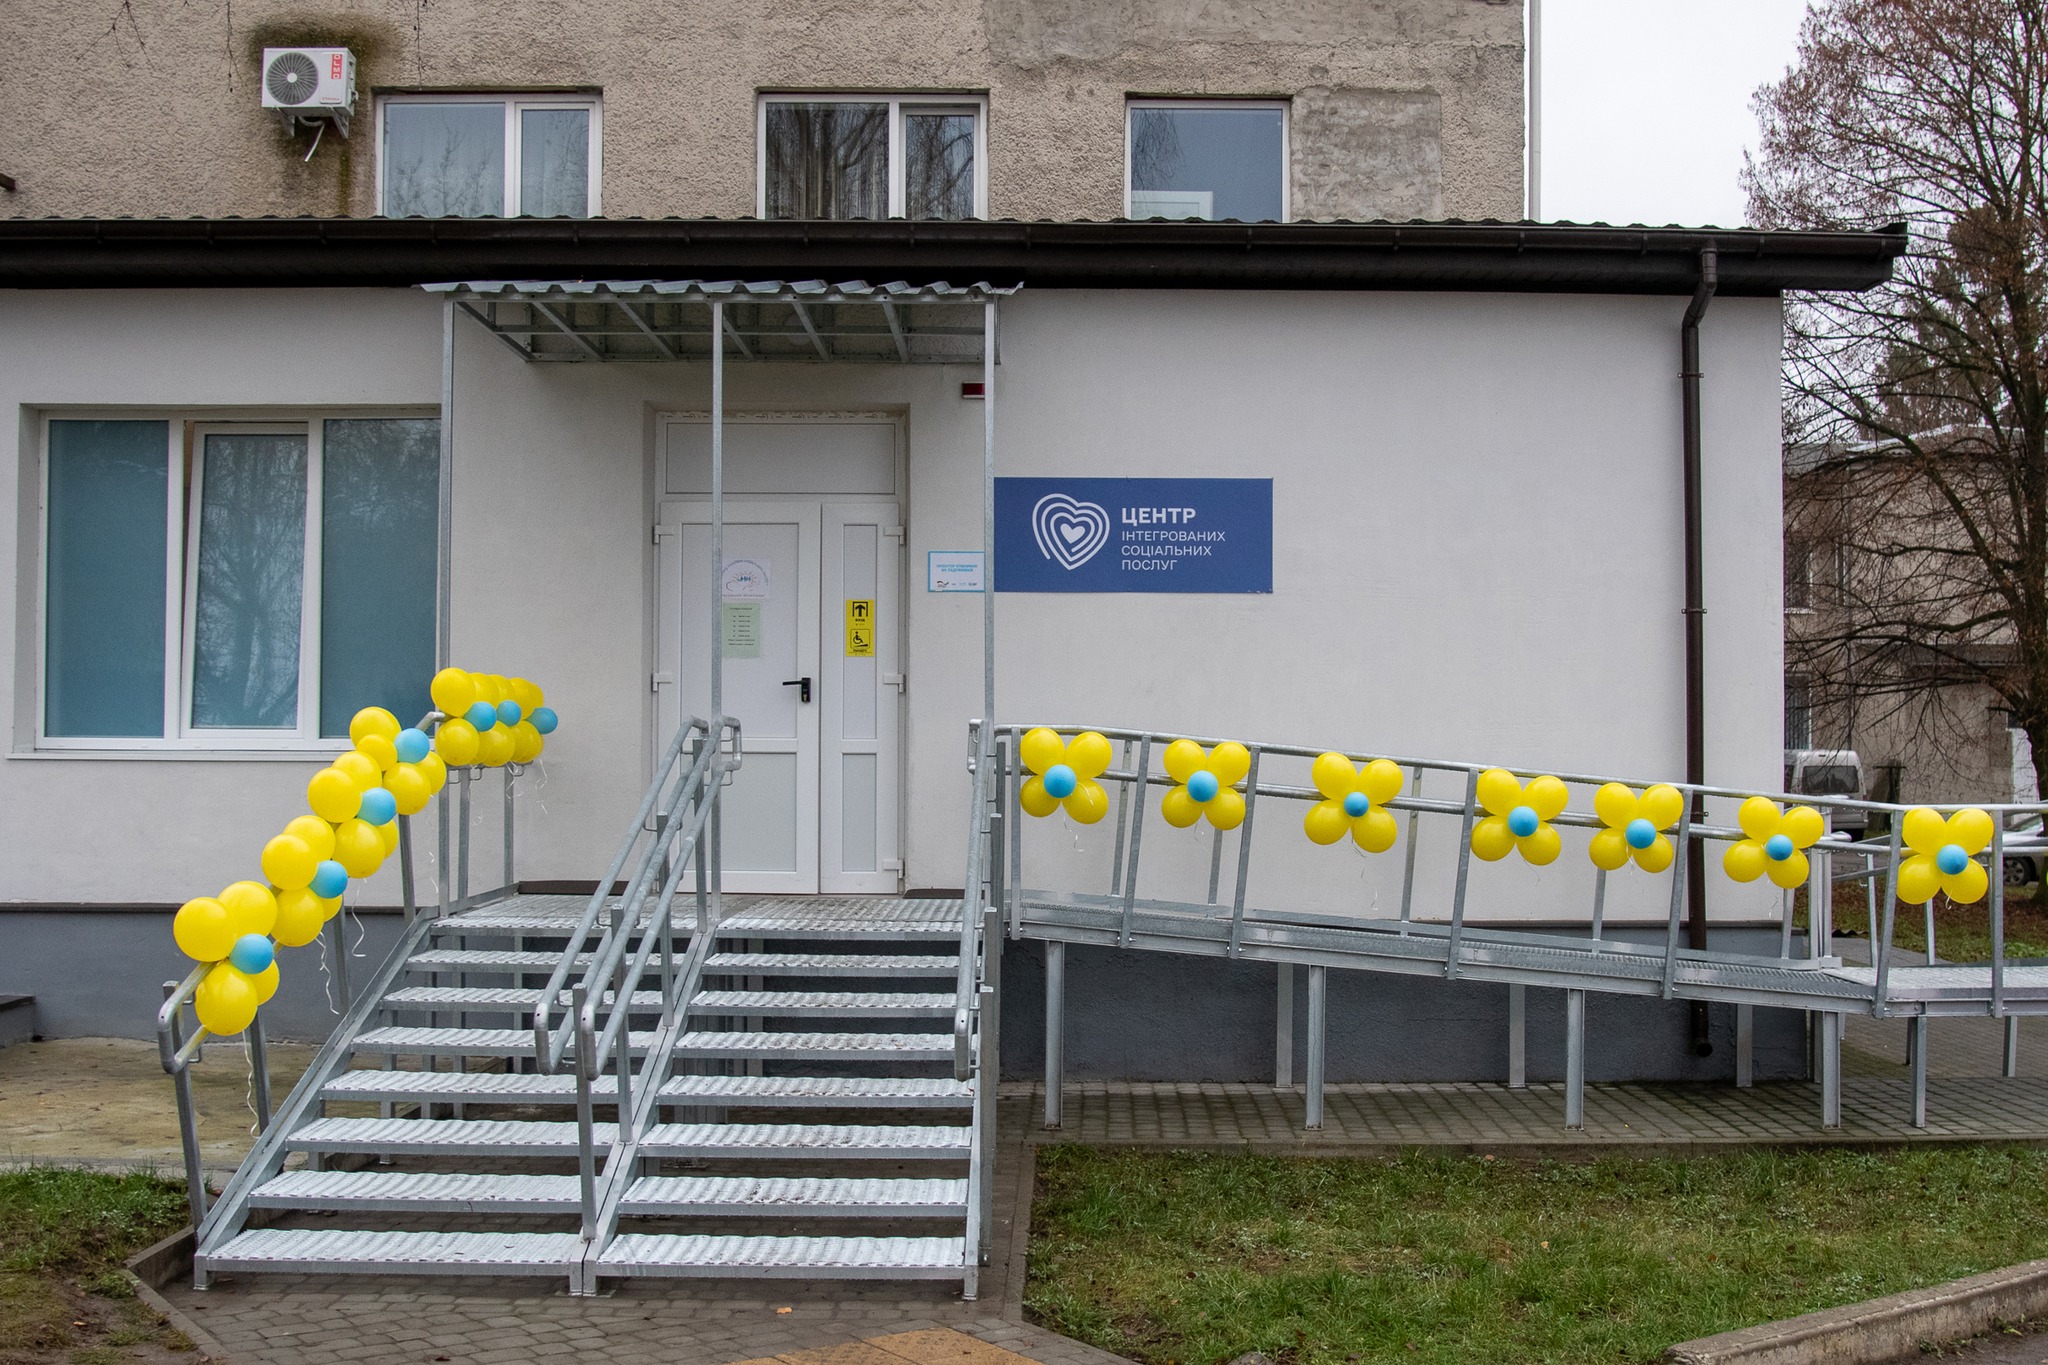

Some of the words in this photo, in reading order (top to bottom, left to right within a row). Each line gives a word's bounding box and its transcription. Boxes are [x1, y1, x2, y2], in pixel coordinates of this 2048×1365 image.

[333, 55, 341, 79] OLMO
[1121, 507, 1196, 527] ЦЕНТР
[1121, 530, 1226, 542] ІНТЕГРОВАНИХ
[1121, 545, 1212, 558] СОЦІАЛЬНИХ
[1121, 559, 1178, 571] ПОСЛУГ
